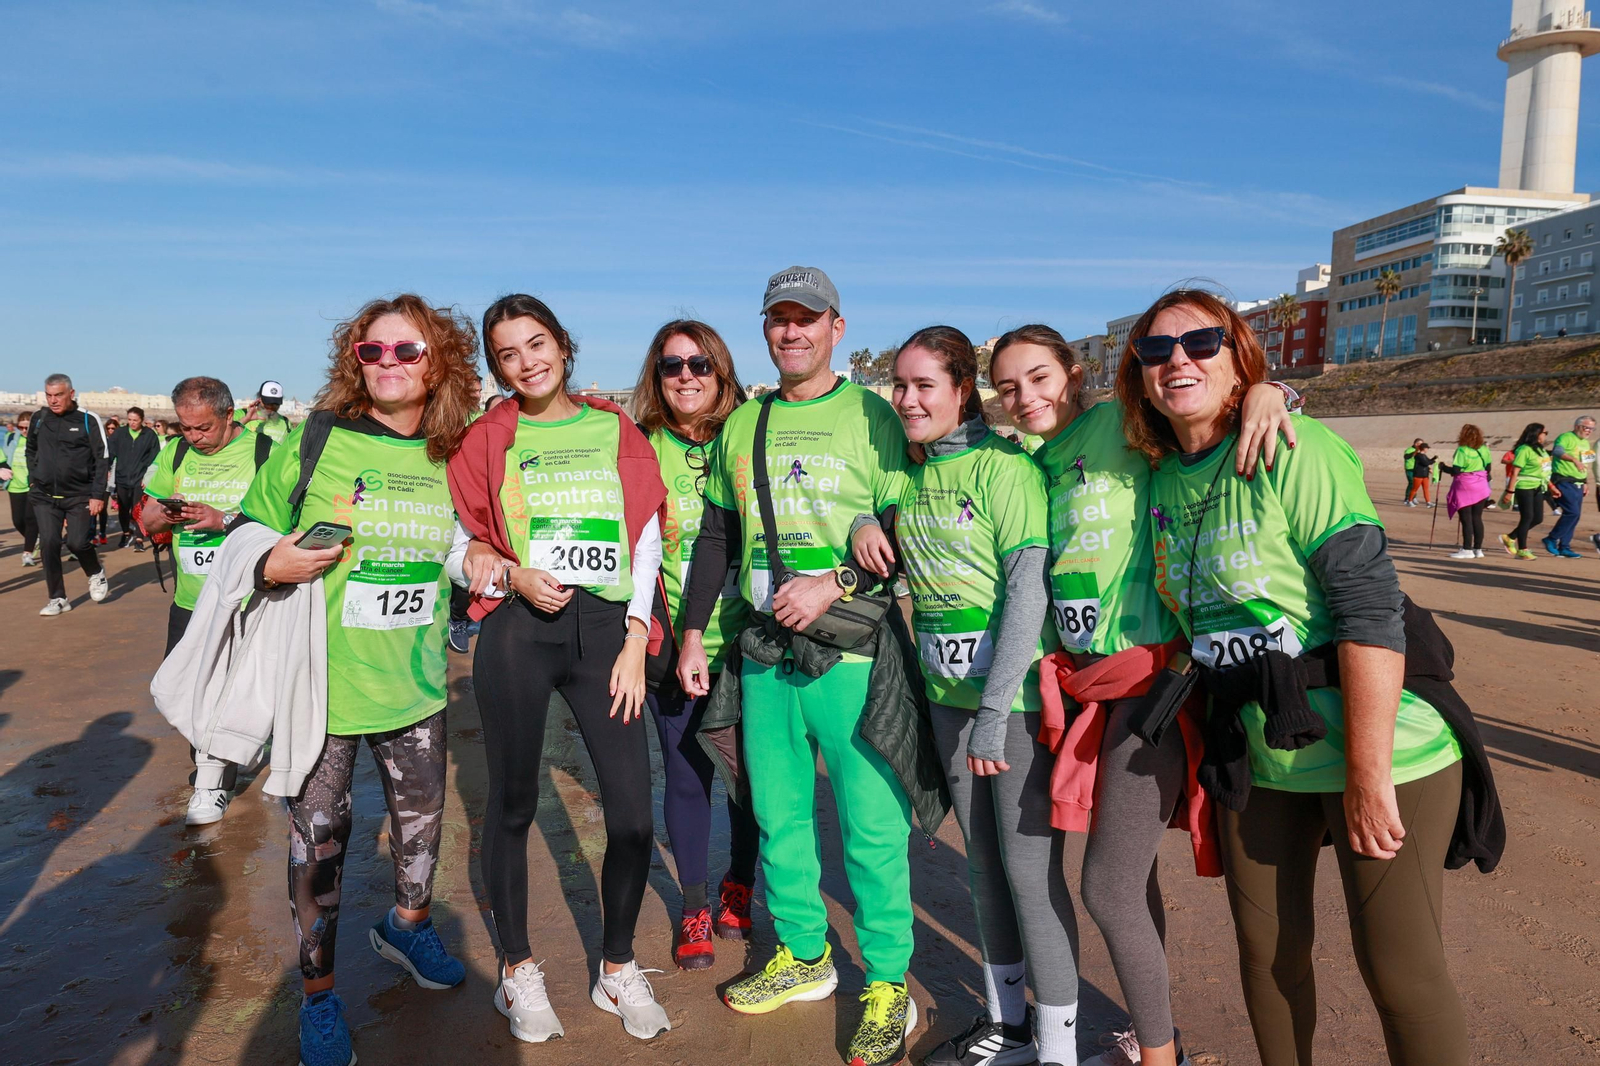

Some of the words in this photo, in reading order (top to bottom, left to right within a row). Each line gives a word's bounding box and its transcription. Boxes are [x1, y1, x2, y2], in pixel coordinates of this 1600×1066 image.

[770, 272, 819, 292] SLOVENIA
[182, 476, 196, 488] En
[200, 478, 248, 490] marcha
[387, 472, 420, 481] asociación
[416, 481, 434, 489] cáncer
[523, 470, 549, 485] En
[554, 468, 620, 483] marcha
[818, 475, 841, 495] el
[528, 486, 604, 506] contra
[606, 488, 623, 506] el
[678, 497, 702, 511] En
[359, 494, 388, 512] En
[394, 500, 454, 520] march
[1052, 508, 1080, 533] ntra
[1082, 498, 1111, 522] el
[357, 520, 442, 540] contra
[443, 528, 454, 544] e
[665, 498, 679, 554] CADIZ
[777, 532, 812, 540] YUNDAI
[950, 536, 976, 554] el
[1064, 528, 1115, 554] cer
[194, 550, 215, 567] 64
[548, 546, 617, 572] 2085
[1230, 541, 1262, 570] el
[376, 589, 425, 616] 125
[1054, 606, 1096, 634] 086
[936, 638, 976, 664] 127
